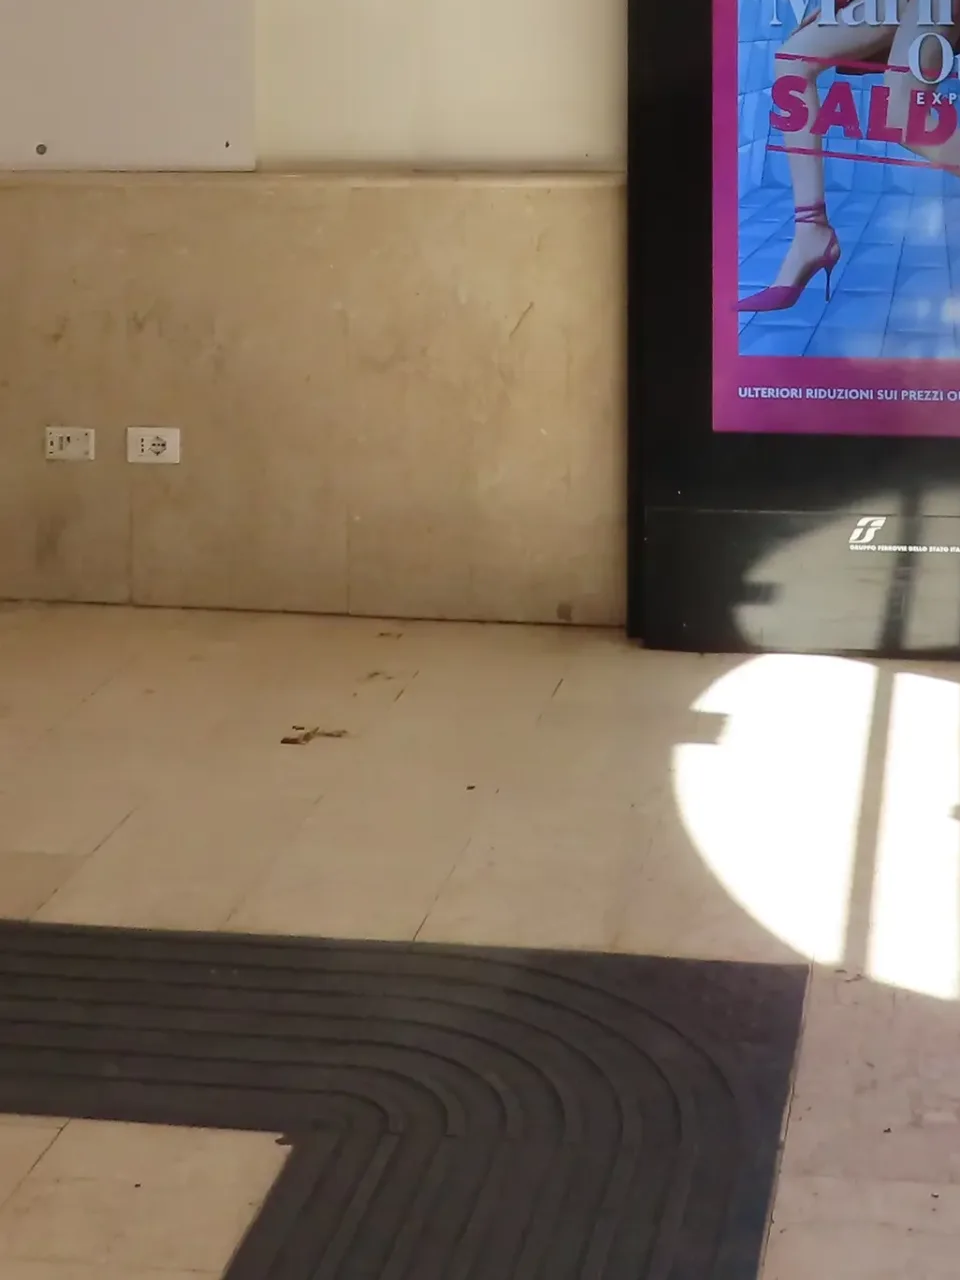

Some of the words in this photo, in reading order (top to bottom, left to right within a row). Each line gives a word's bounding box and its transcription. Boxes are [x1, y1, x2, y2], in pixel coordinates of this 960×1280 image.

[738, 386, 803, 400] ULTERIORI
[805, 388, 874, 401] RIDUZIONI
[877, 389, 899, 401] SUI
[901, 389, 944, 402] PREZZI
